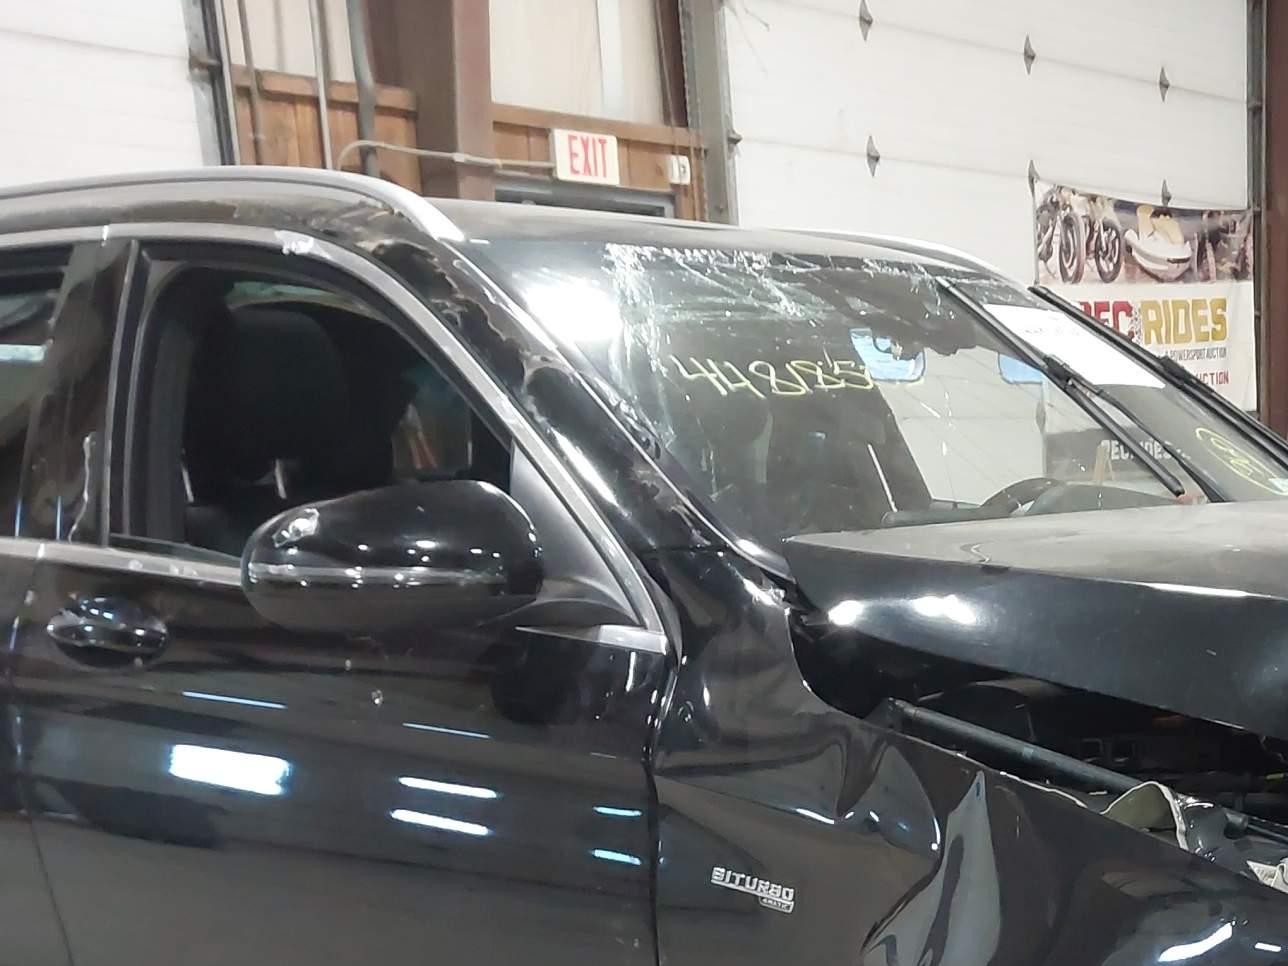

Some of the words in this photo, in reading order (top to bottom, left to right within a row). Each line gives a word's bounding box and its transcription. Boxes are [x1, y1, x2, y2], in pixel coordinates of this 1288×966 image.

[567, 134, 607, 178] EXIT
[1141, 298, 1228, 345] RIDES
[711, 866, 794, 901] BITURBO
